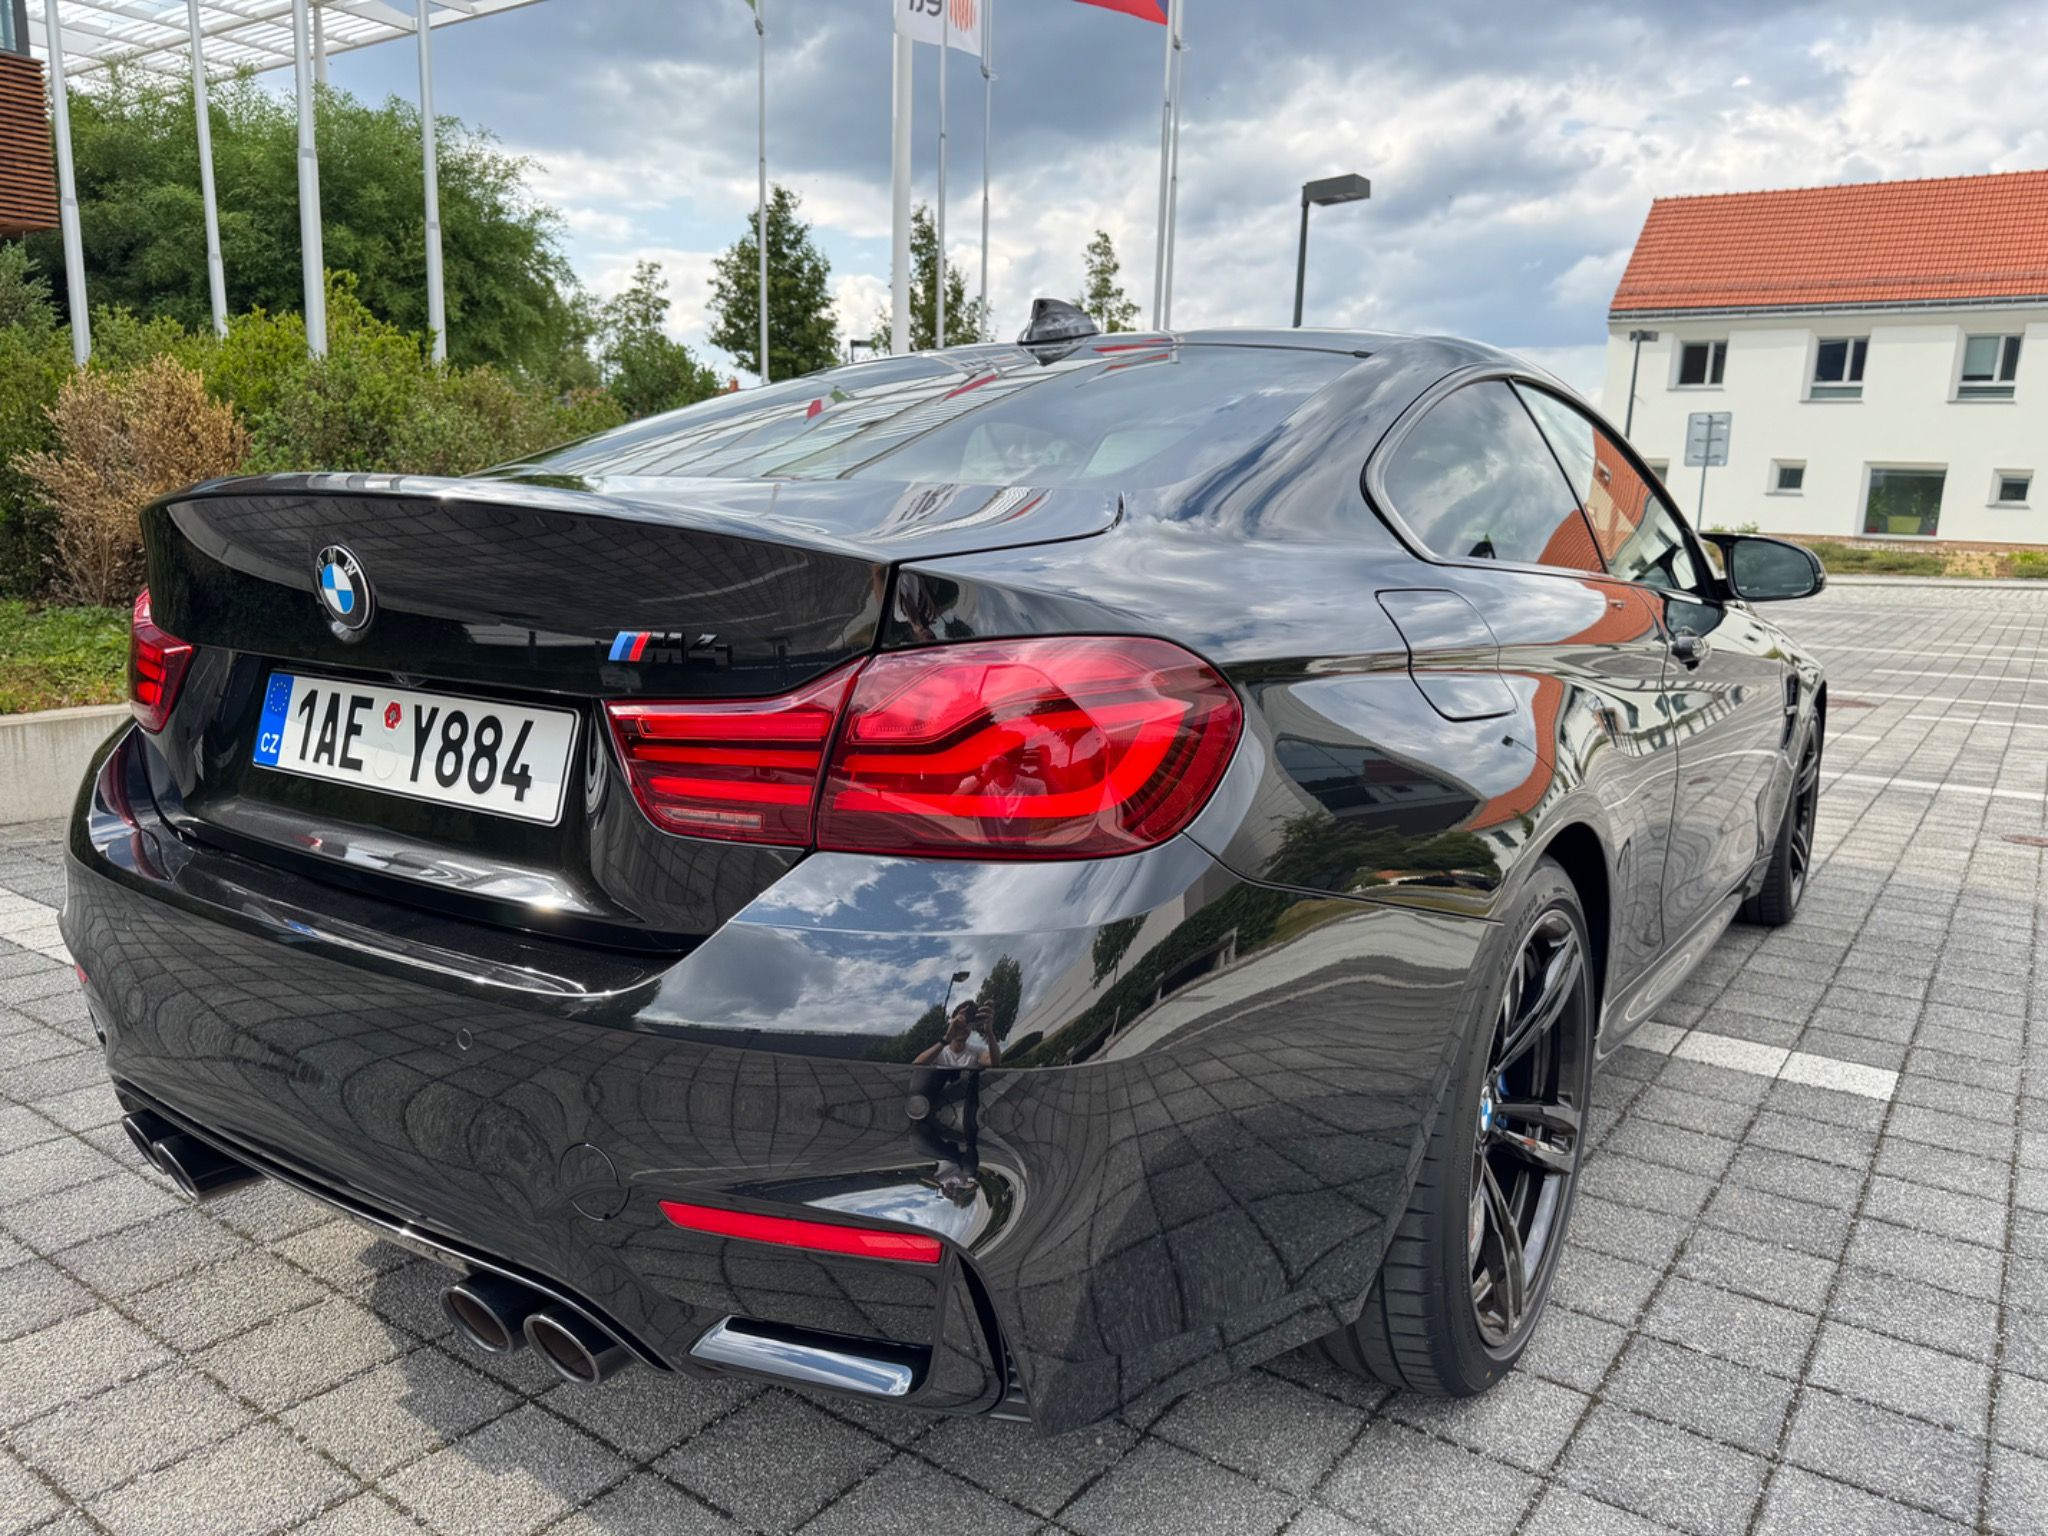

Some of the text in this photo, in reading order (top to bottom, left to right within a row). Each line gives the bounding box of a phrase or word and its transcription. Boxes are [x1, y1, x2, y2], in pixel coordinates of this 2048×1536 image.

[317, 548, 358, 576] BMW
[640, 631, 730, 666] M4
[260, 733, 280, 754] CZ
[298, 689, 534, 802] 1AE Y884
